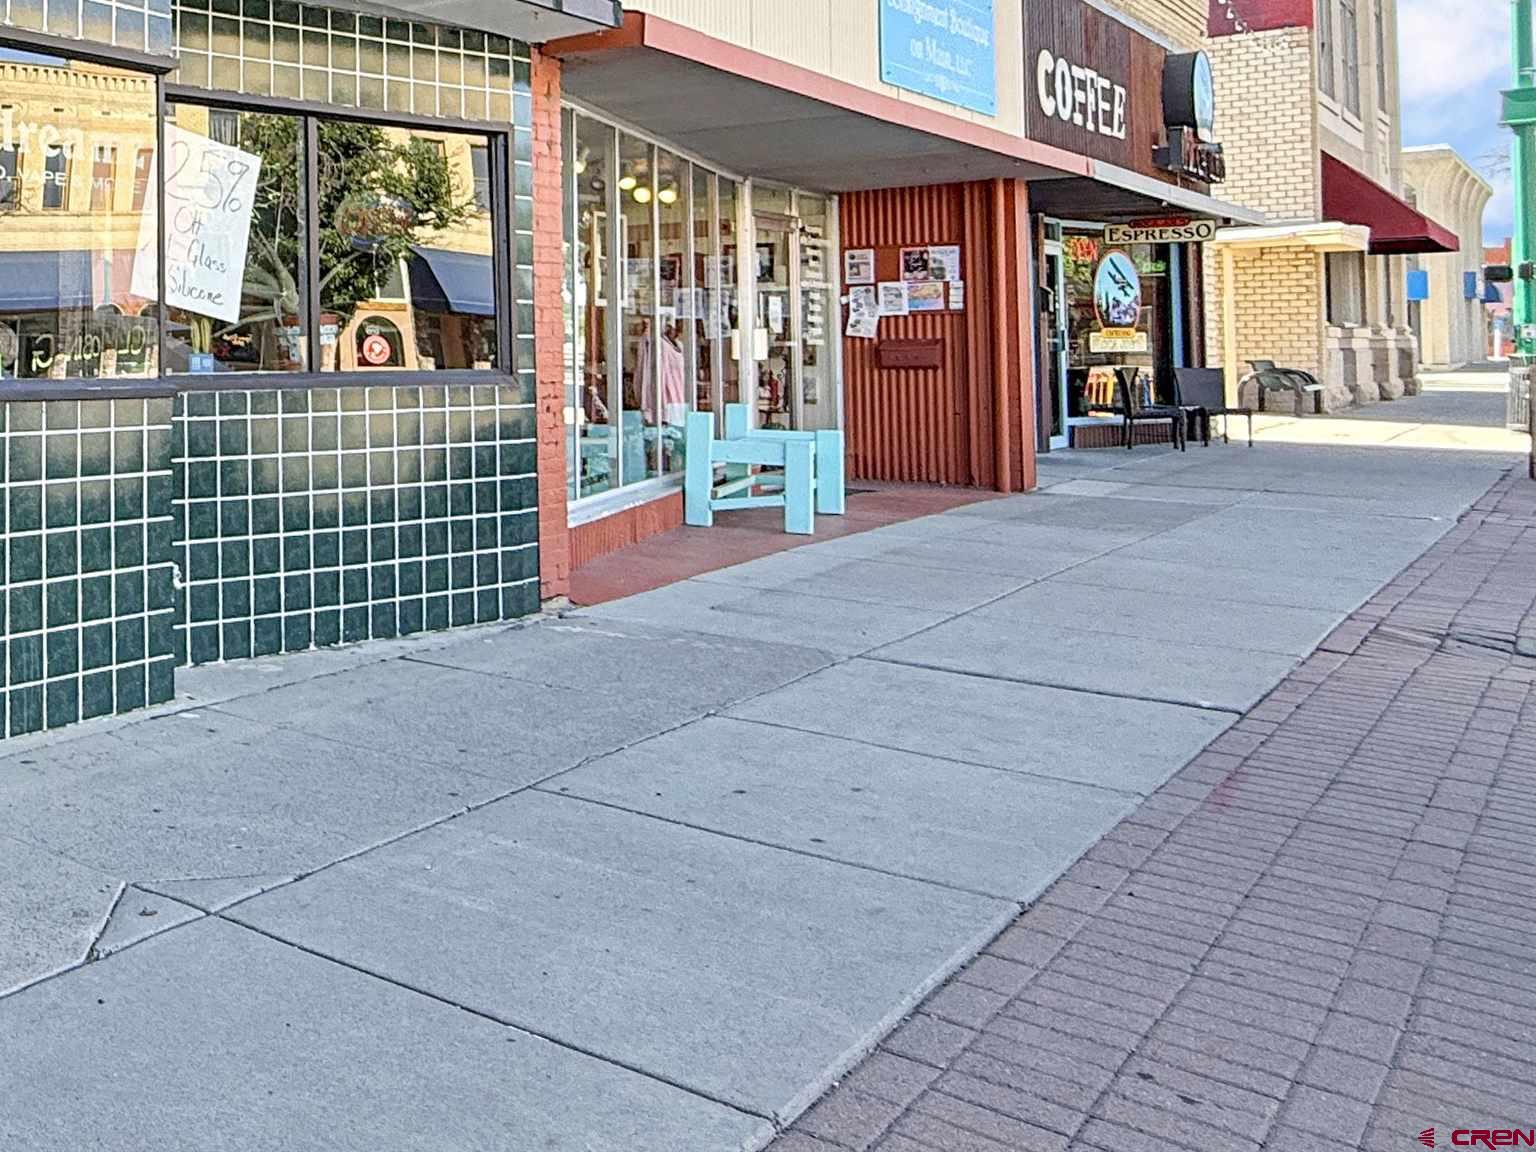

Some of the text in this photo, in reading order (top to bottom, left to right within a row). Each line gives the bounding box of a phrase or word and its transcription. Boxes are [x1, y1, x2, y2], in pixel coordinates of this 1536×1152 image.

[1037, 48, 1127, 140] COFFEE
[165, 140, 250, 213] 25%
[1108, 223, 1212, 243] ESPRESSO
[187, 238, 228, 274] Glass
[168, 264, 226, 306] Silicone
